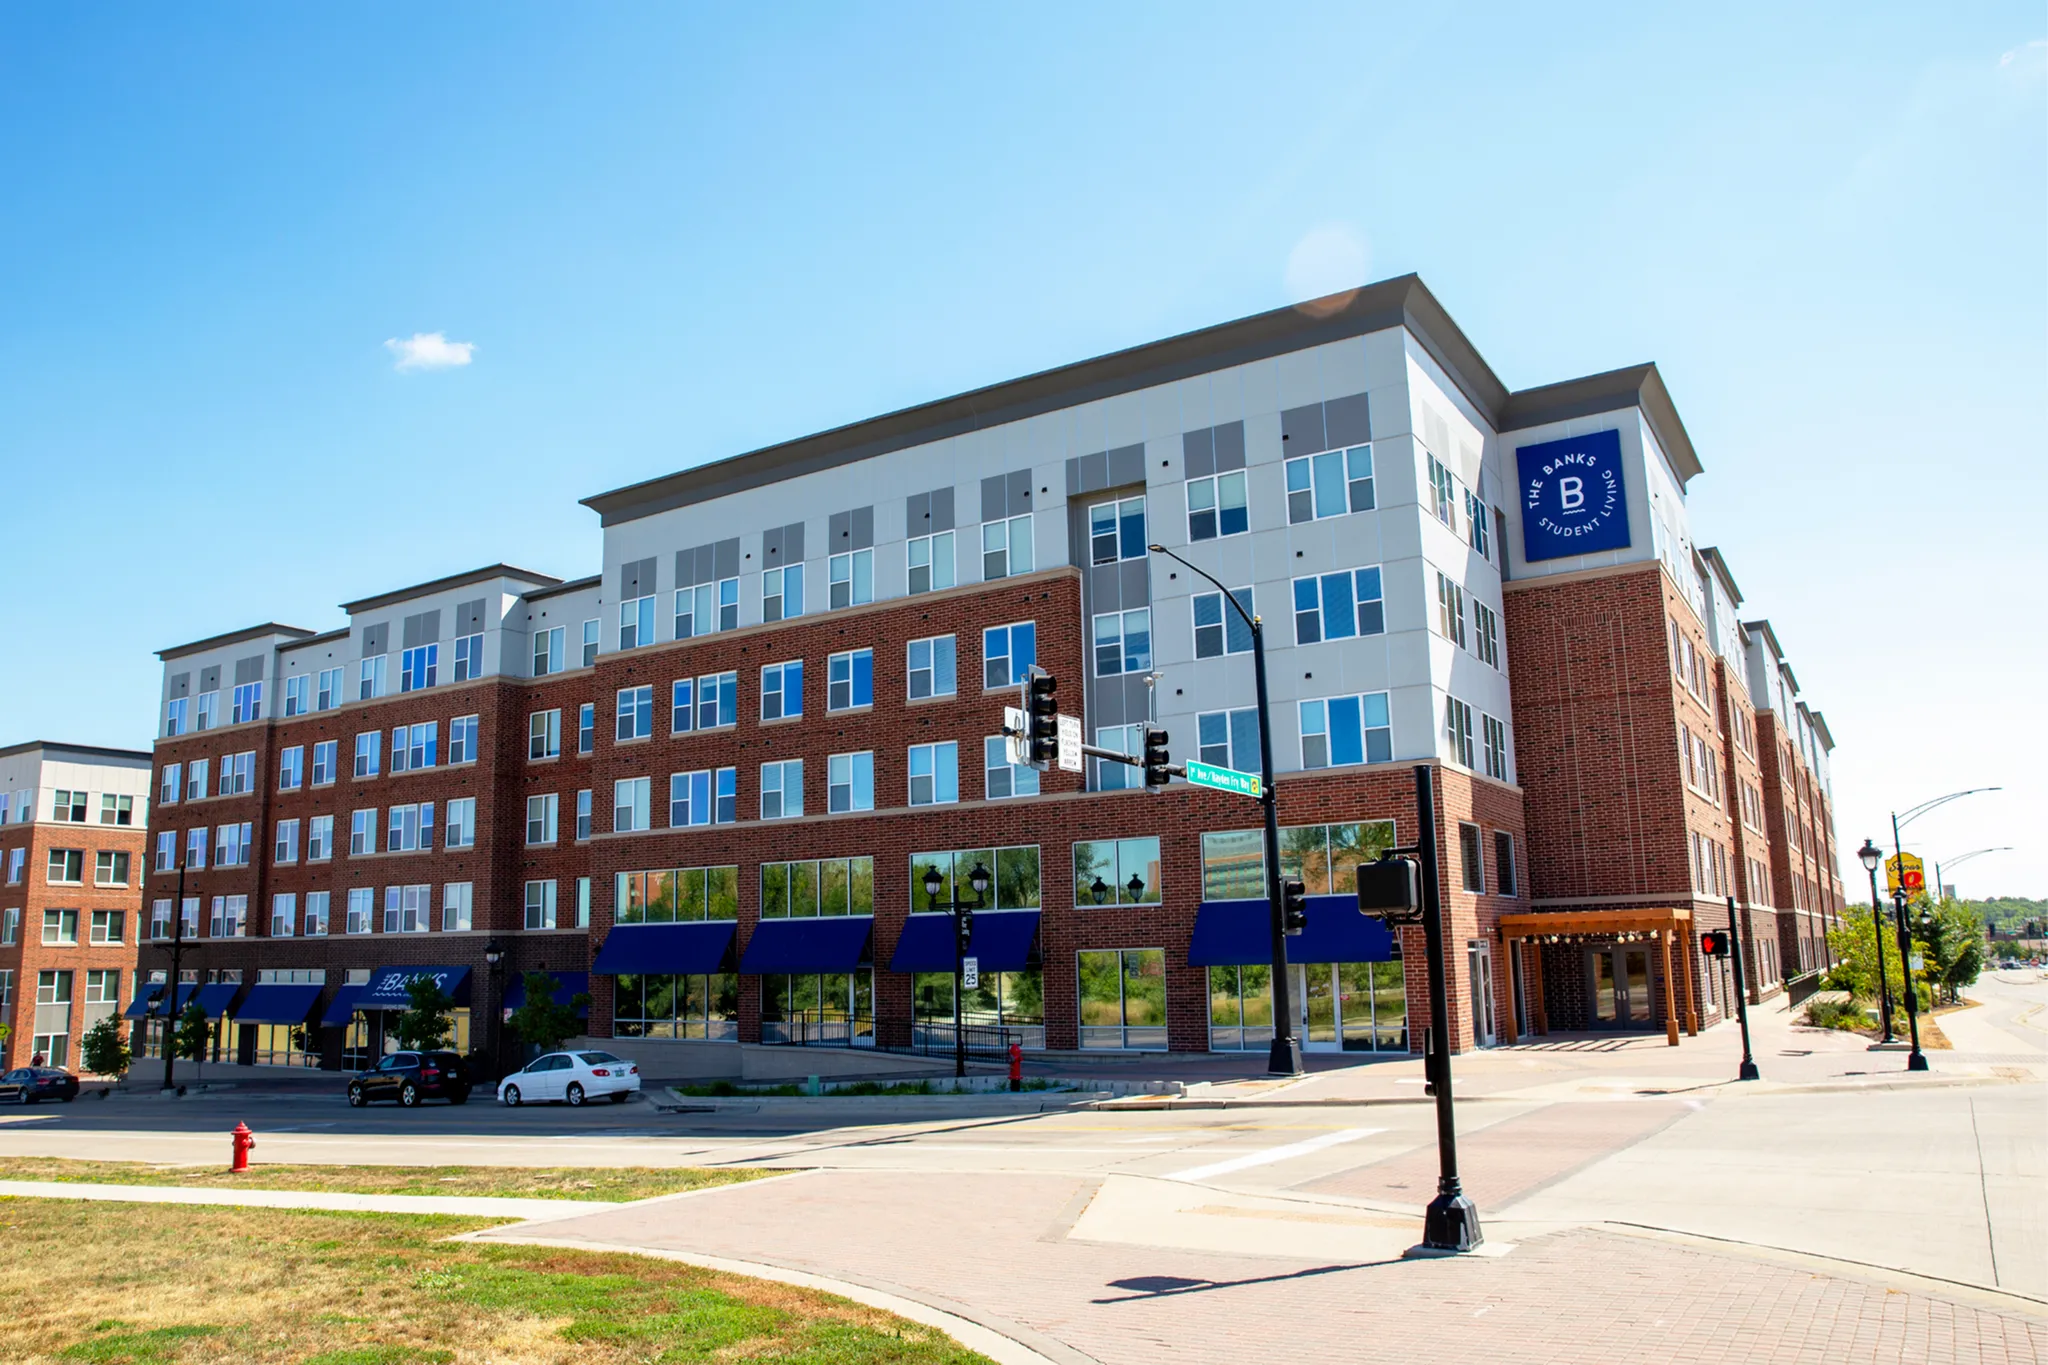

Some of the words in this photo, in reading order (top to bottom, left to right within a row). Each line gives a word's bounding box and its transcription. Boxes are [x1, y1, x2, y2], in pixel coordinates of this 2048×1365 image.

[1529, 479, 1543, 509] THE
[1542, 453, 1597, 475] BANKS
[1560, 476, 1585, 509] B
[1539, 517, 1600, 537] STUDENT
[1600, 470, 1617, 517] LIVING
[1889, 861, 1921, 873] Sper
[965, 973, 977, 985] 25
